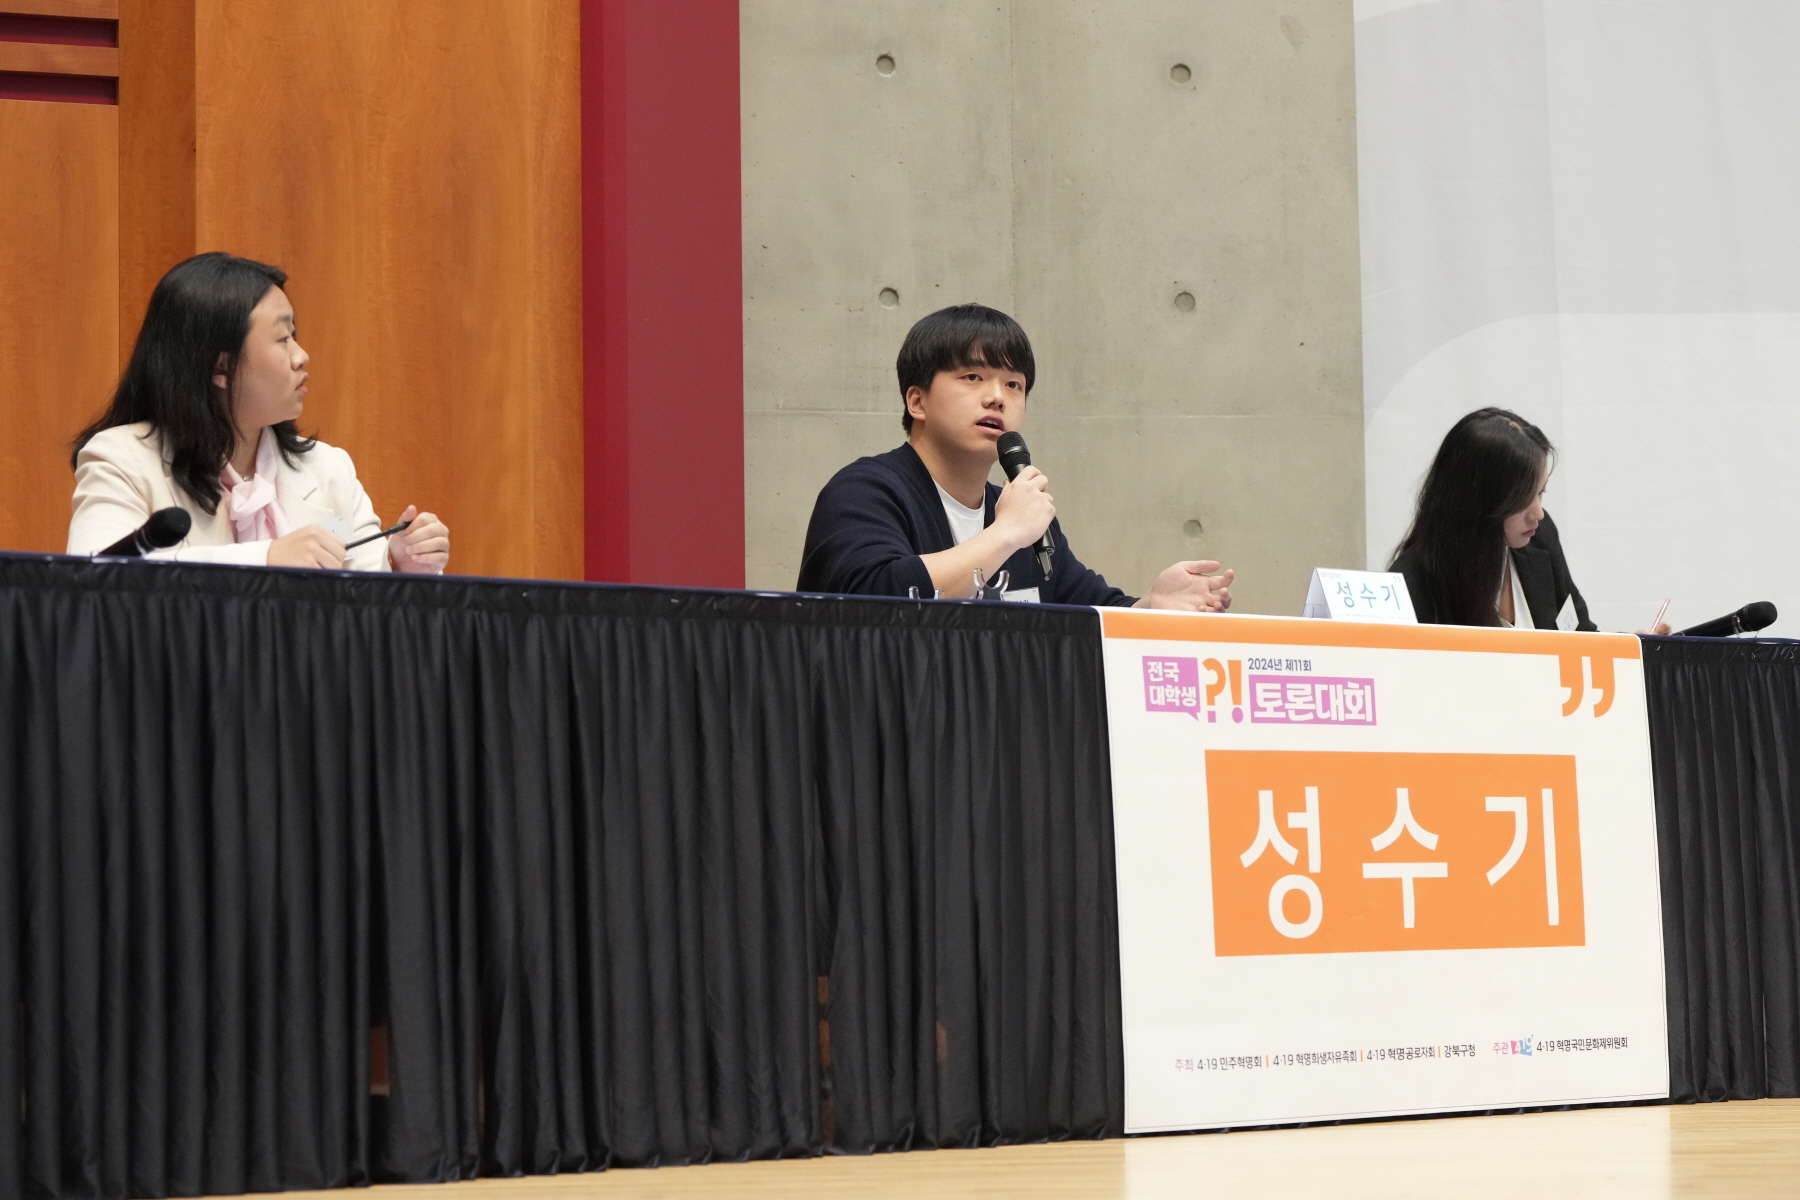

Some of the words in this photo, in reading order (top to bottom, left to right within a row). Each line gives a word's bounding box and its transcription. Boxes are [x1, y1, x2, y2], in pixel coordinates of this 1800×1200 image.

[1147, 661, 1180, 683] 전국
[1247, 657, 1283, 671] 2024년
[1285, 659, 1312, 672] 제11회
[1149, 684, 1197, 707] 대학생
[1253, 681, 1373, 722] 토론대회
[1492, 1041, 1509, 1055] 주관
[1556, 1036, 1628, 1053] 혁명국민문화제위원회
[1175, 1058, 1194, 1072] 주최
[1219, 1055, 1262, 1071] 민주혁명회
[1295, 1049, 1357, 1067] 혁명희생자유족회
[1387, 1045, 1436, 1061] 혁명공로자회
[1443, 1043, 1476, 1059] 강북구청
